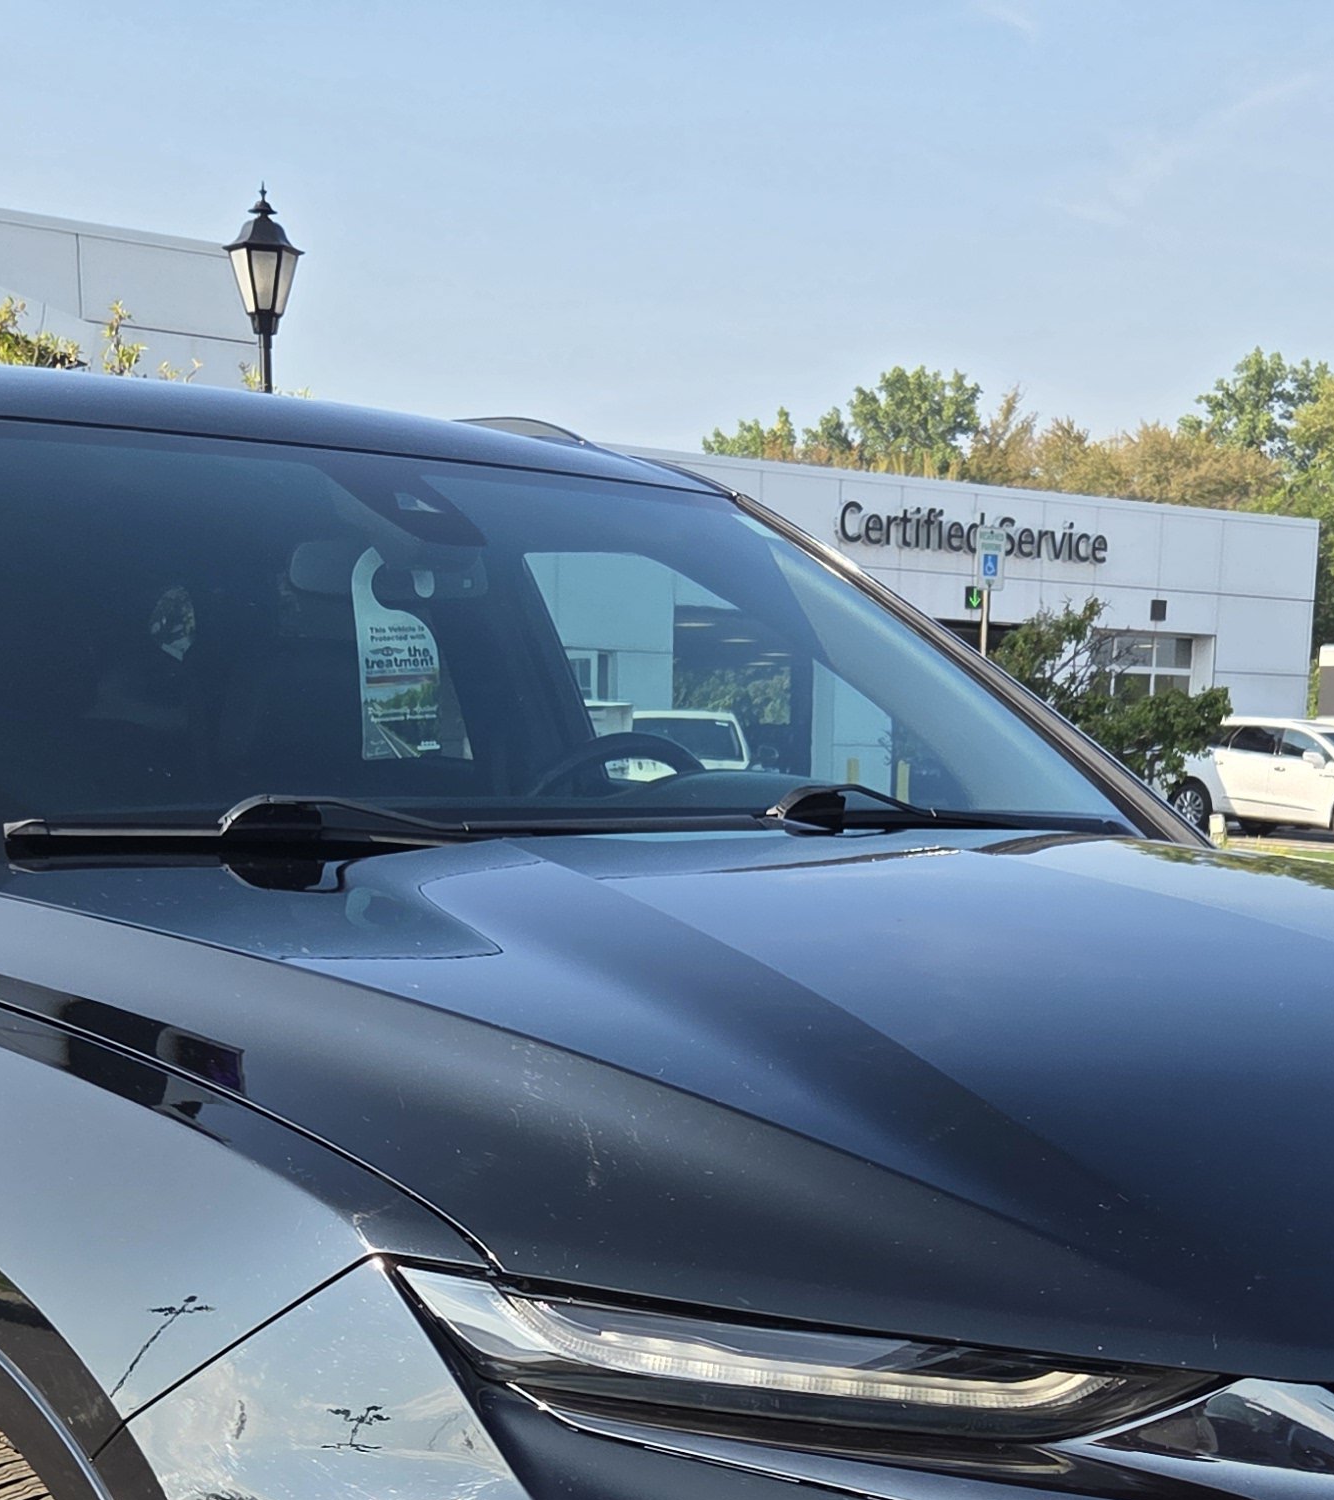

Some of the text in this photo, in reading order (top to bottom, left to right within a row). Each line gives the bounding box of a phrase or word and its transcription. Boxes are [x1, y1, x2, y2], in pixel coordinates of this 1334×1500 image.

[839, 500, 985, 554] Certified
[999, 516, 1108, 563] Service
[370, 634, 408, 642] Protected
[365, 656, 434, 668] treatment
